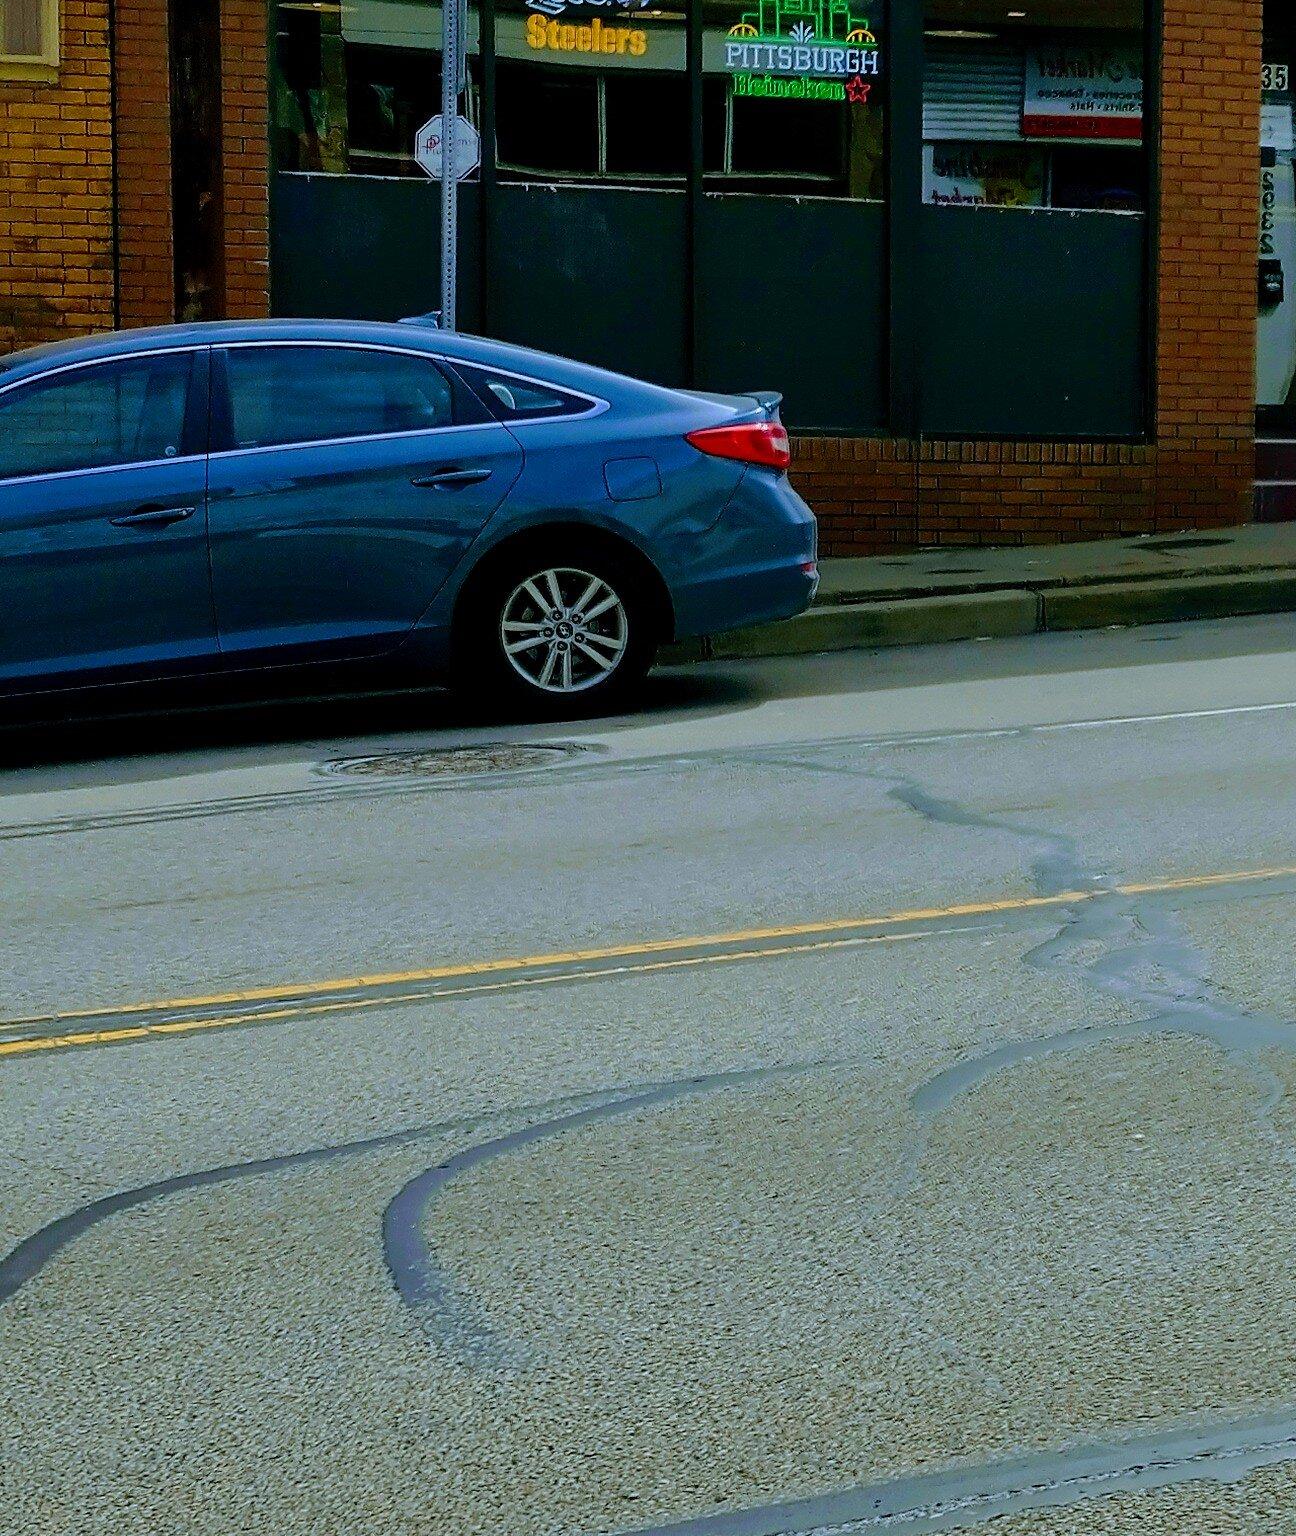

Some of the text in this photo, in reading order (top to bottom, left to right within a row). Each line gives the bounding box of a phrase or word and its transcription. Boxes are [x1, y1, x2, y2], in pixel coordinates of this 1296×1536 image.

[526, 13, 646, 56] Steelers
[724, 42, 879, 75] PITTSBURGH
[732, 72, 846, 101] Heineken
